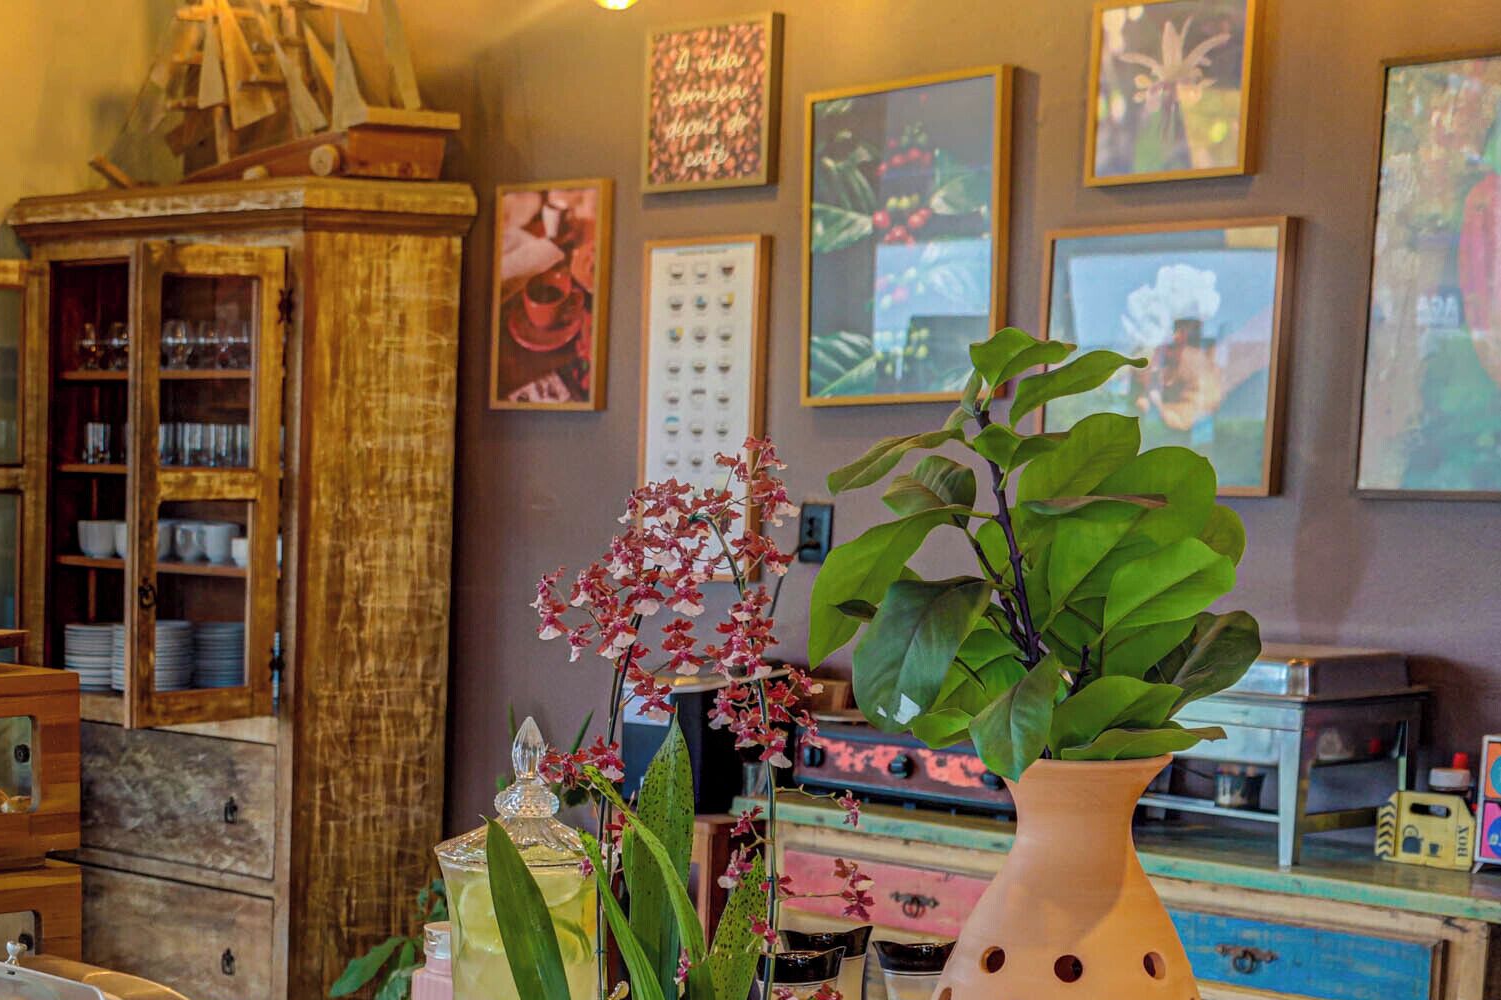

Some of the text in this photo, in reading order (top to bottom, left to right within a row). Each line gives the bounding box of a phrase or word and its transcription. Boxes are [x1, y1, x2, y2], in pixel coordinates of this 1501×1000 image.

[674, 42, 747, 75] A vida
[667, 84, 749, 108] começa
[663, 107, 749, 150] depois do
[683, 140, 730, 170] café
